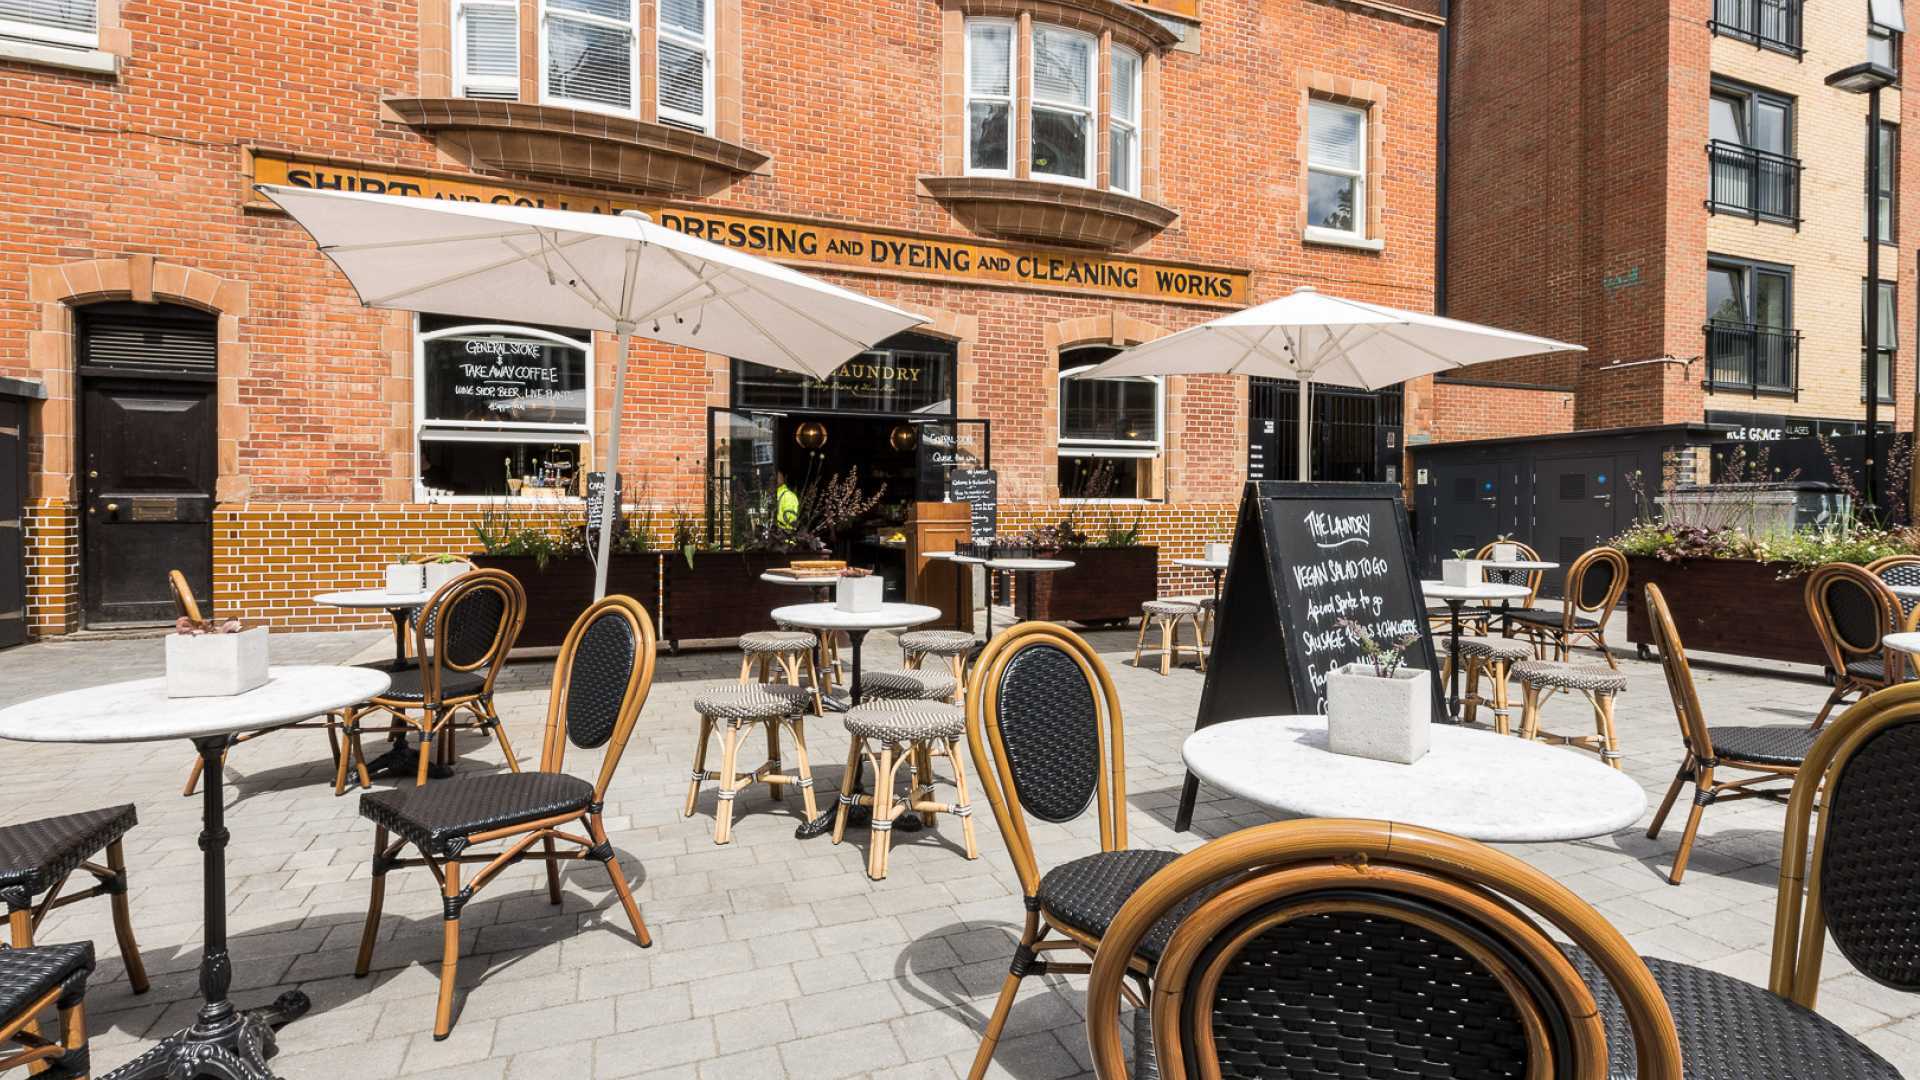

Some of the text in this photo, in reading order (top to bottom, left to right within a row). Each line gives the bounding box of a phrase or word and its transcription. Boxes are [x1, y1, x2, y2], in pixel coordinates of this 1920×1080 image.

[661, 214, 818, 255] DRESSING
[827, 238, 864, 257] AND
[870, 240, 970, 272] DYEING
[977, 255, 1011, 272] AND
[1016, 255, 1138, 289] CLEANING
[1155, 270, 1233, 298] WORKS
[514, 366, 558, 383] COFFEE
[831, 363, 920, 381] AUNDRY
[1748, 427, 1782, 441] GRACE
[1304, 509, 1370, 538] THE LAUNDRY
[1292, 556, 1388, 591] VEGAN SALAD TO GO
[1359, 588, 1370, 610] to
[1372, 596, 1383, 617] go
